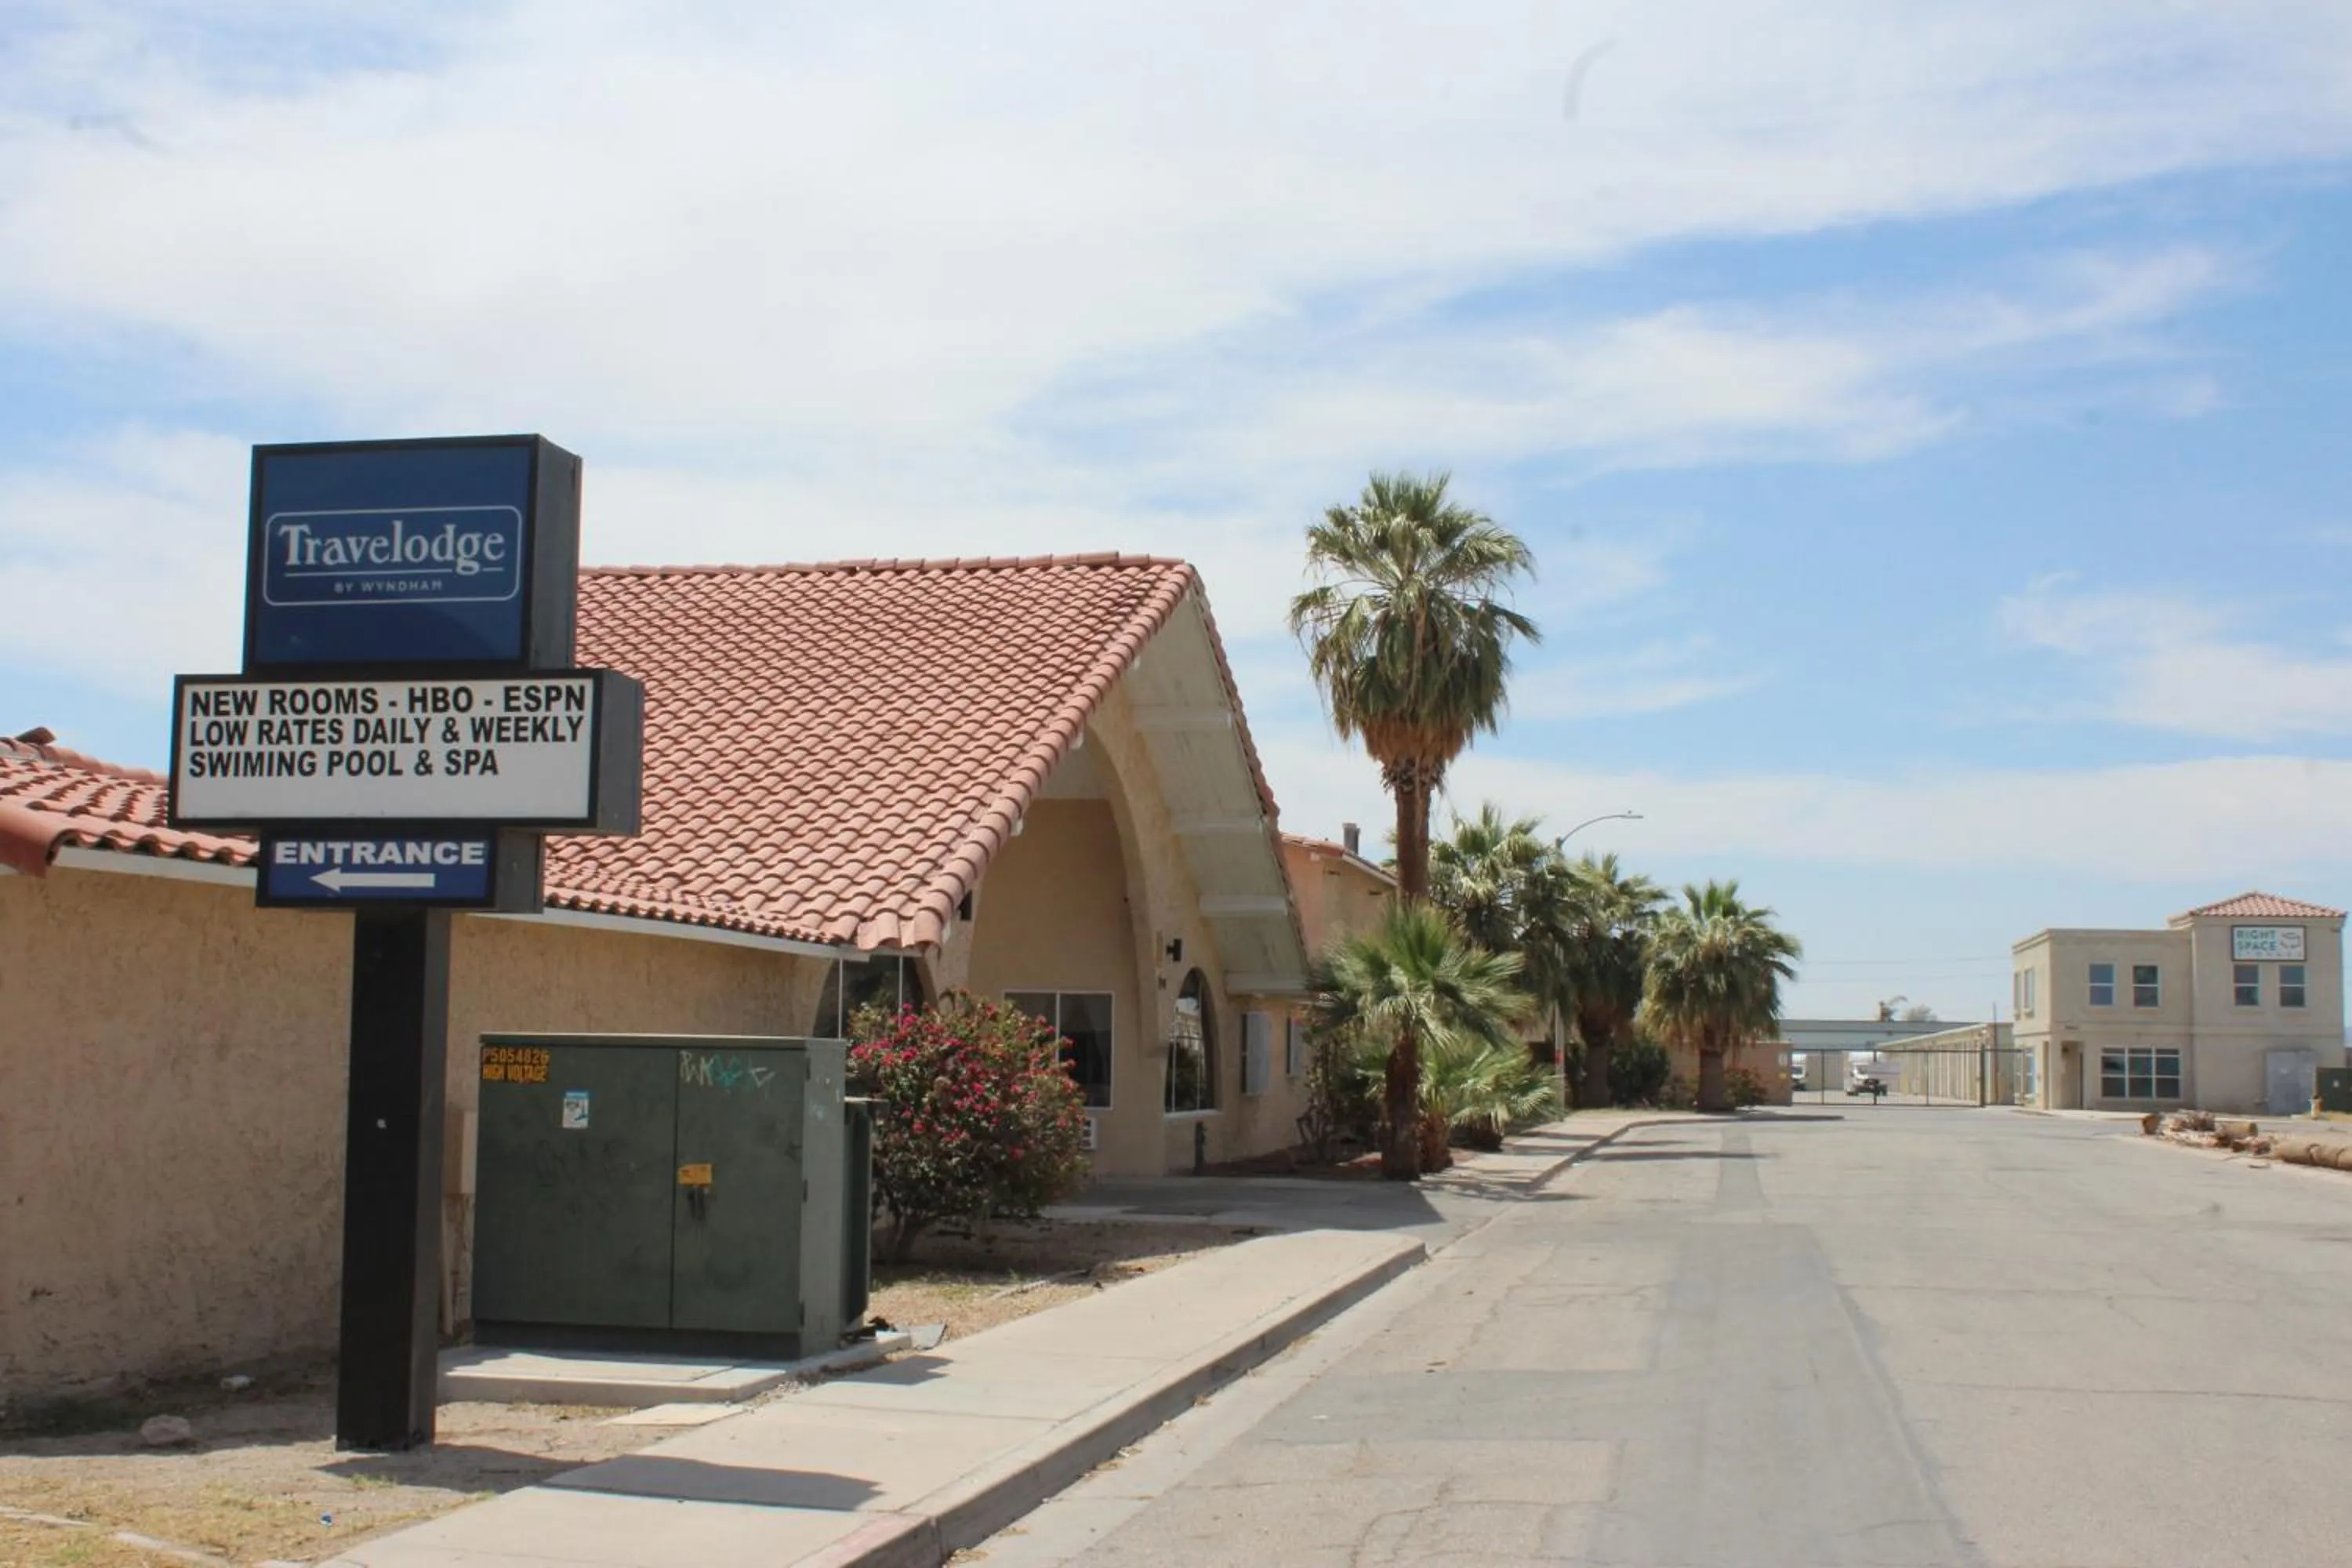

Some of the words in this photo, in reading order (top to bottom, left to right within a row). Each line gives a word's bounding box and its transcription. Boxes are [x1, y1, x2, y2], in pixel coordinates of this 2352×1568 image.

[278, 521, 505, 575] Travelodge
[334, 581, 353, 593] BY
[361, 579, 442, 593] WYNDHAM
[191, 689, 258, 716] NEW
[269, 688, 379, 714] ROOMS
[408, 686, 474, 713] HBO
[503, 685, 586, 711] ESPN
[190, 720, 249, 746] LOW
[257, 717, 343, 745] RATES
[354, 717, 431, 743] DAILY
[441, 717, 460, 742] &
[470, 716, 584, 742] WEEKLY
[189, 751, 318, 777] SWIMING
[327, 750, 403, 776] POOL
[414, 750, 434, 775] &
[445, 750, 499, 775] SPA
[275, 841, 485, 865] ENTRANCE
[507, 1065, 547, 1082] VOLTAGE
